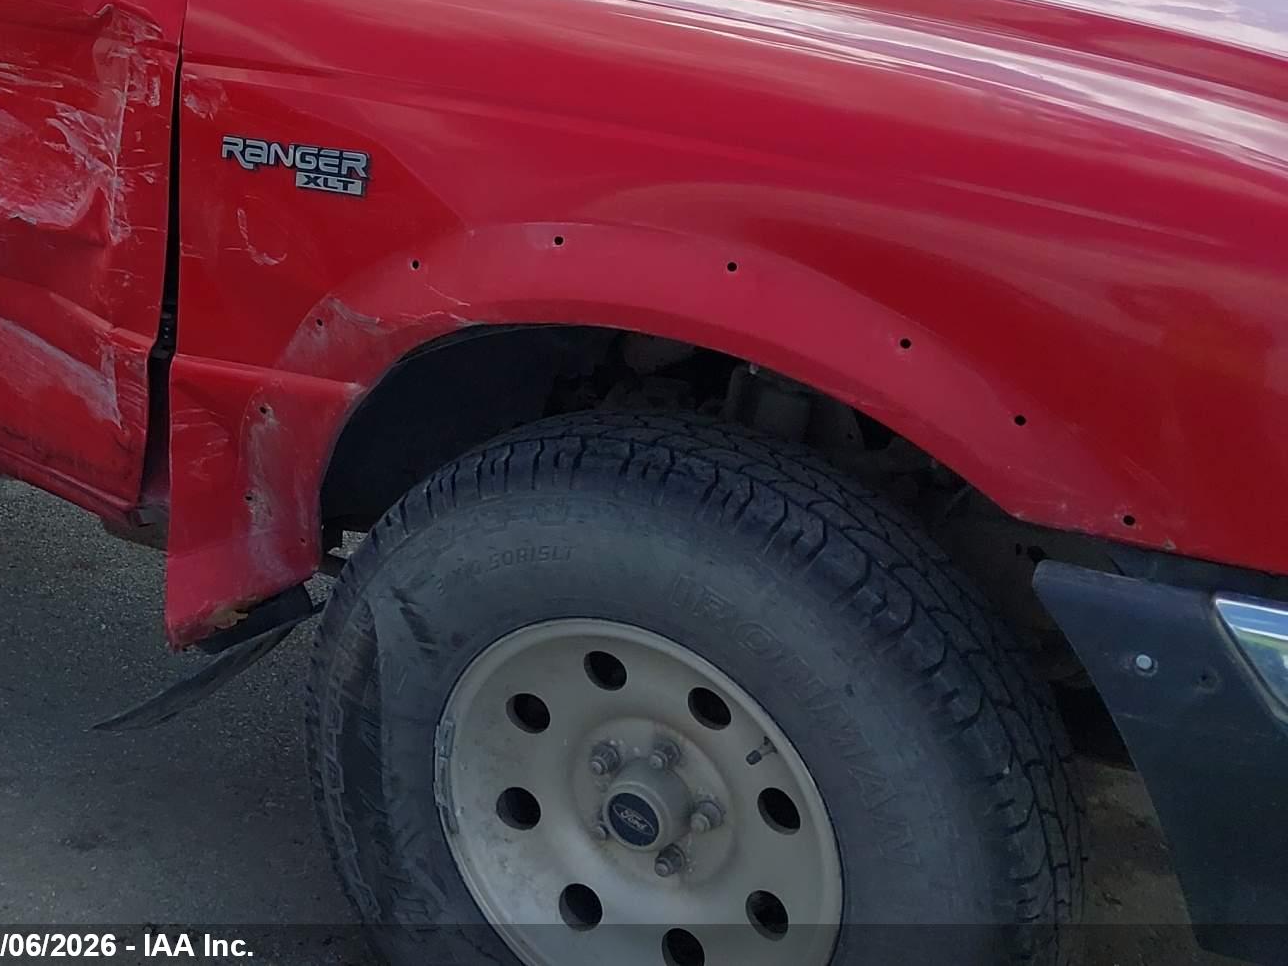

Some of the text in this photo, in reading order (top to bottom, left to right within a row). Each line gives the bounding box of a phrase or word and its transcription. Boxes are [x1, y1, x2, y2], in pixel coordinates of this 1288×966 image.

[221, 135, 371, 179] RANGER
[300, 173, 357, 193] XLT
[617, 807, 651, 832] Ford
